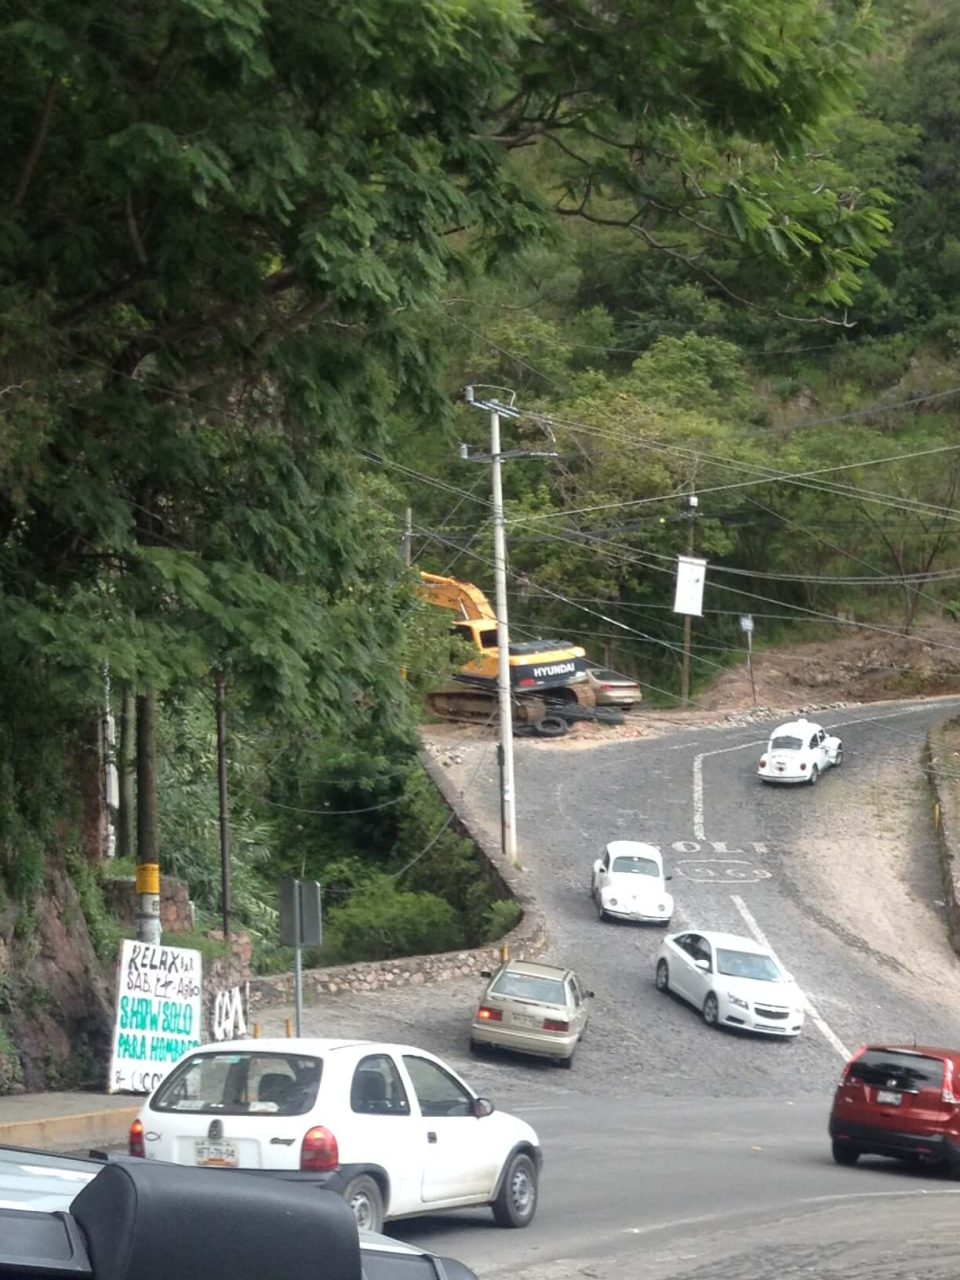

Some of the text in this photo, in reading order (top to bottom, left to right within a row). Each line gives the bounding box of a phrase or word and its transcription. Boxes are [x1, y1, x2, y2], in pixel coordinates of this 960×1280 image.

[533, 662, 575, 678] HYUNDAI
[128, 944, 180, 974] RELAX
[120, 995, 193, 1036] SHOW SOLO
[117, 1033, 146, 1060] PARA
